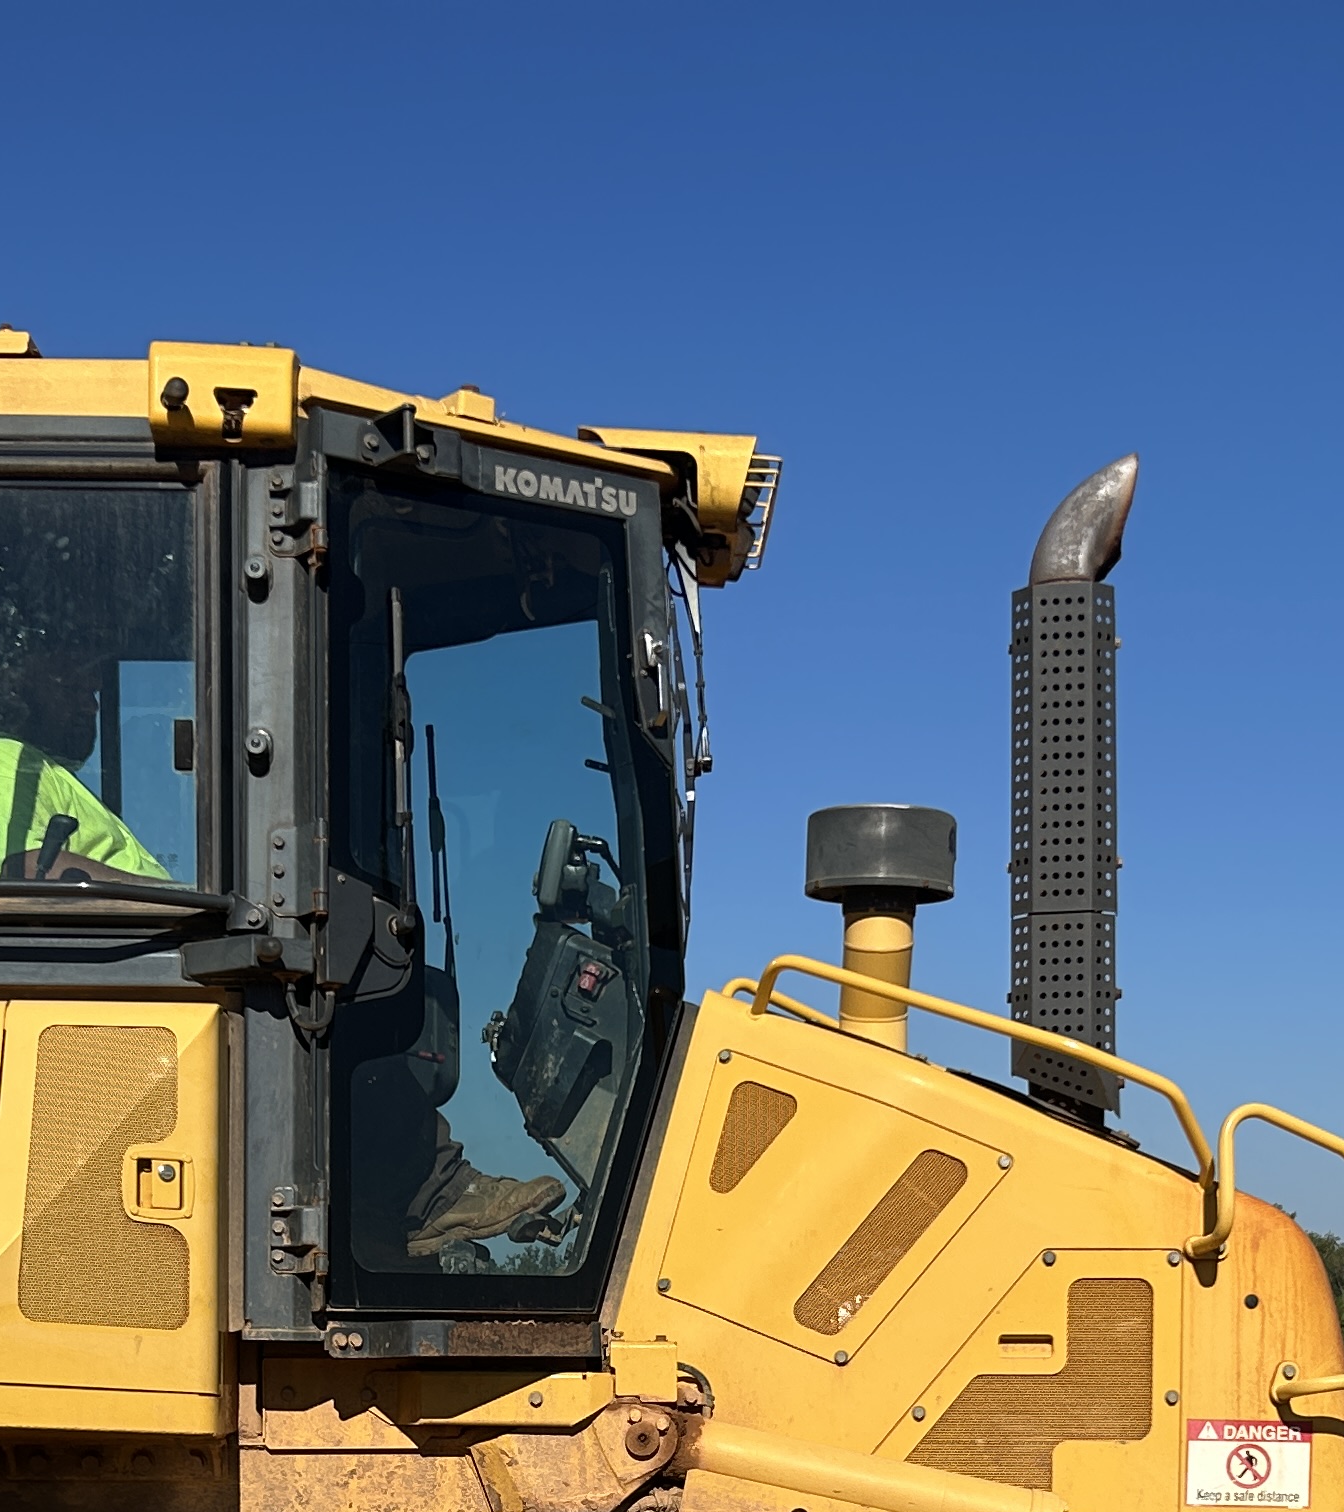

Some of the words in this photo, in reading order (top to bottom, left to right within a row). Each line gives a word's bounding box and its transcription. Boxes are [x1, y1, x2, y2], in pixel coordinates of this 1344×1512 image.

[495, 464, 637, 516] KOMATSU
[1223, 1424, 1302, 1442] DANGER
[1196, 1489, 1222, 1503] Keep
[1233, 1489, 1255, 1502] safe
[1257, 1489, 1301, 1503] distance
